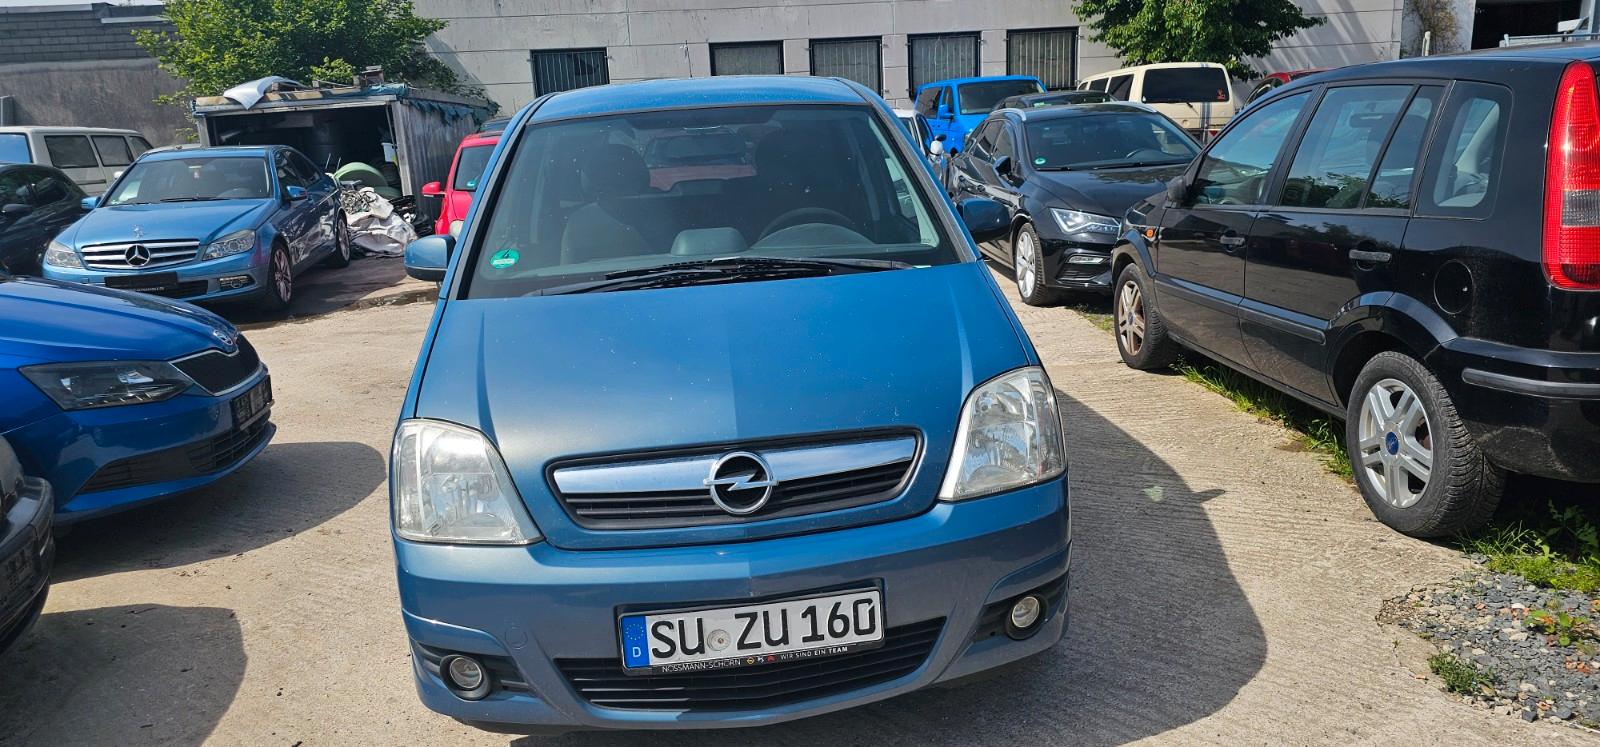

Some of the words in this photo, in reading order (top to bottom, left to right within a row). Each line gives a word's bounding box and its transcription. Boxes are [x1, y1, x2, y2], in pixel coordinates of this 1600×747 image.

[650, 617, 705, 659] SU
[734, 608, 789, 651] ZU
[801, 598, 876, 643] 160
[632, 646, 642, 658] D
[780, 652, 794, 660] WIR
[795, 650, 812, 658] SIND
[828, 646, 848, 654] TEAM
